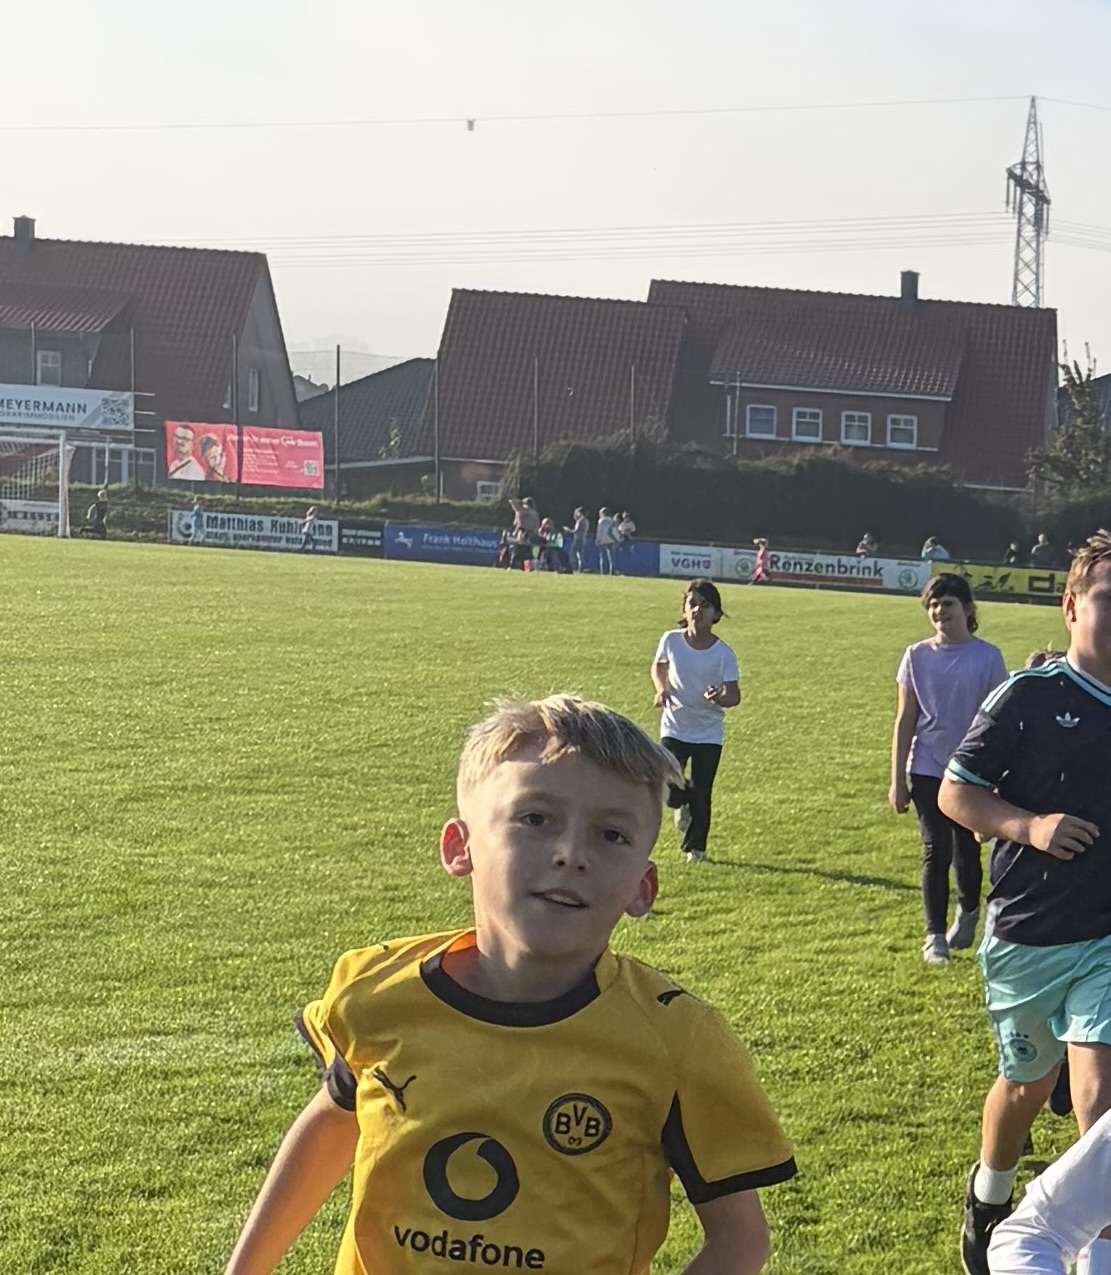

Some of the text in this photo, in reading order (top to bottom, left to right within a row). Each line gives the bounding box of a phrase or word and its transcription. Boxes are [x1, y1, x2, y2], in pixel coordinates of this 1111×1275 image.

[206, 515, 264, 532] Matthias
[423, 533, 450, 545] Frank
[671, 558, 701, 569] VGH
[769, 554, 884, 577] Renzenbrink
[555, 1104, 601, 1137] BVB
[394, 1225, 545, 1269] vodafone
